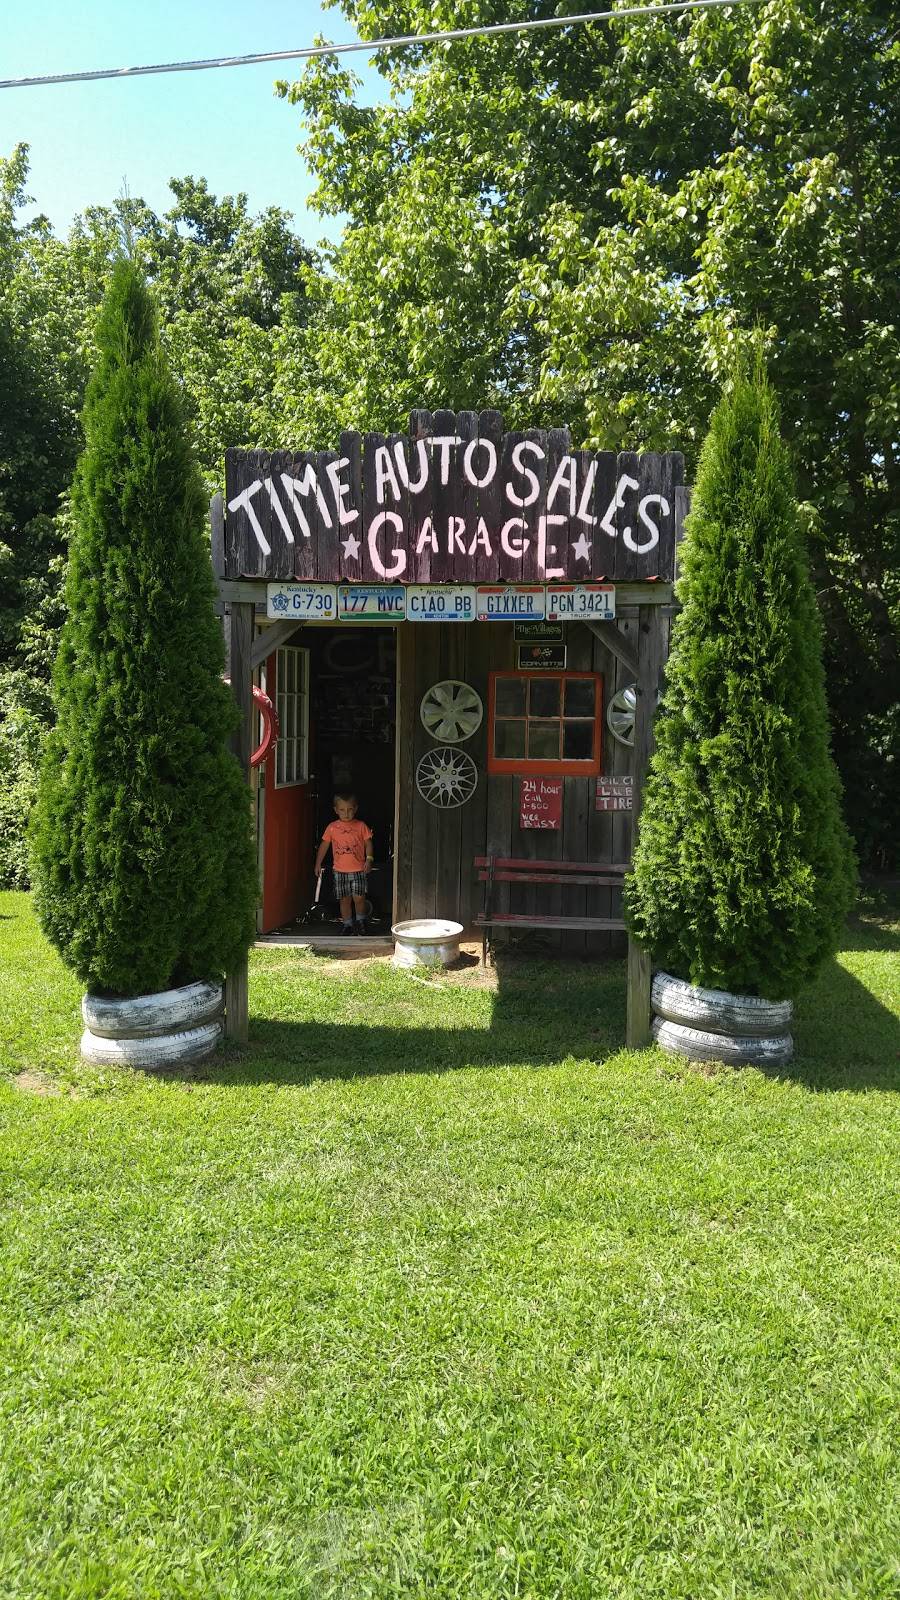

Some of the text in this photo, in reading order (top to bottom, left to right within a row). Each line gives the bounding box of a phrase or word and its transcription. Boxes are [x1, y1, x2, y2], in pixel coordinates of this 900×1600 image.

[228, 436, 670, 555] TIME AUTO SALES
[367, 511, 568, 579] GARAGE
[293, 594, 332, 610] G-730
[343, 596, 404, 612] 177 MVC
[411, 596, 472, 612] CIAO BB
[487, 596, 533, 612] GIXXER
[551, 593, 610, 612] PGN 3421
[523, 781, 562, 795] 24 hour
